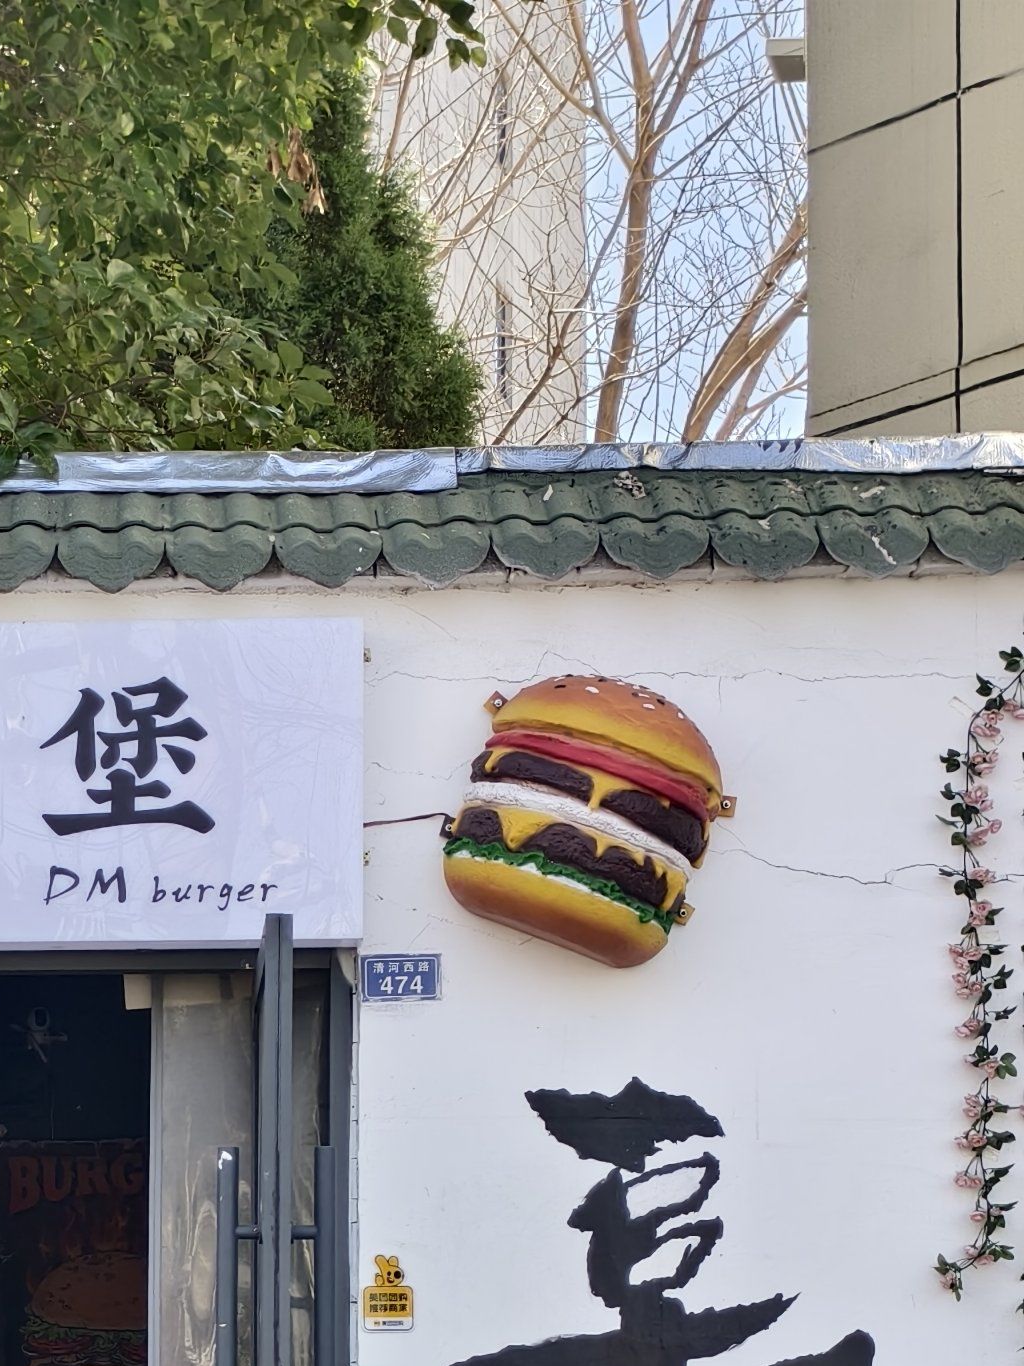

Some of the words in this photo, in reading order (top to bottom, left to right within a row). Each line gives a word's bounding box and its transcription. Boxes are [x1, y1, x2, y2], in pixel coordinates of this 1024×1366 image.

[43, 865, 127, 905] DM
[151, 875, 278, 911] burger
[373, 961, 430, 974] 清河西路
[380, 975, 424, 994] 474
